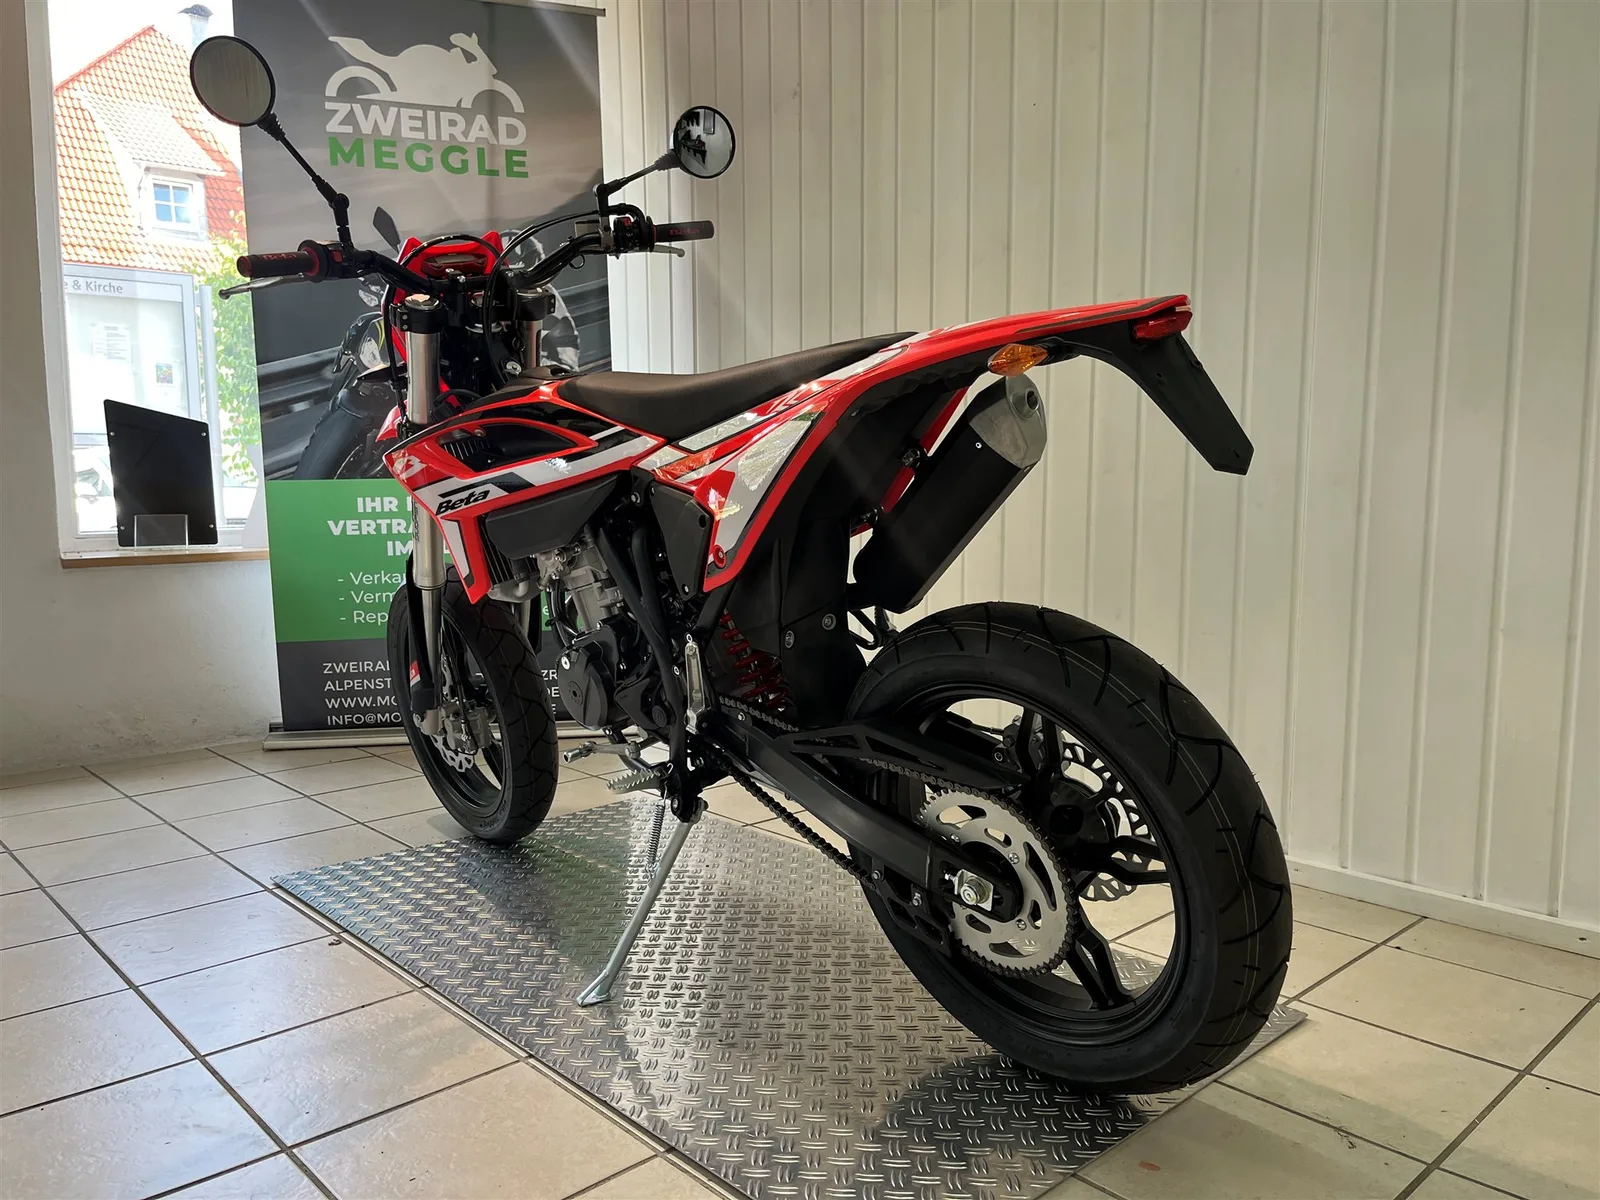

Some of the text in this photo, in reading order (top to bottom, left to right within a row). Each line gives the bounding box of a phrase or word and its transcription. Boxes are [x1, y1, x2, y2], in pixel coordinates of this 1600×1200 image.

[324, 101, 527, 146] ZWEIRAD
[328, 136, 529, 178] MEGGLE
[72, 279, 82, 291] &
[85, 280, 123, 294] Kirche
[357, 496, 398, 513] IHR
[435, 489, 490, 516] Beta
[327, 518, 413, 536] VERTR
[387, 540, 413, 557] IM
[353, 610, 388, 626] Rep
[322, 660, 390, 674] ZWEIRA
[324, 677, 392, 692] ALPENST
[327, 712, 402, 726] INFO@MO
